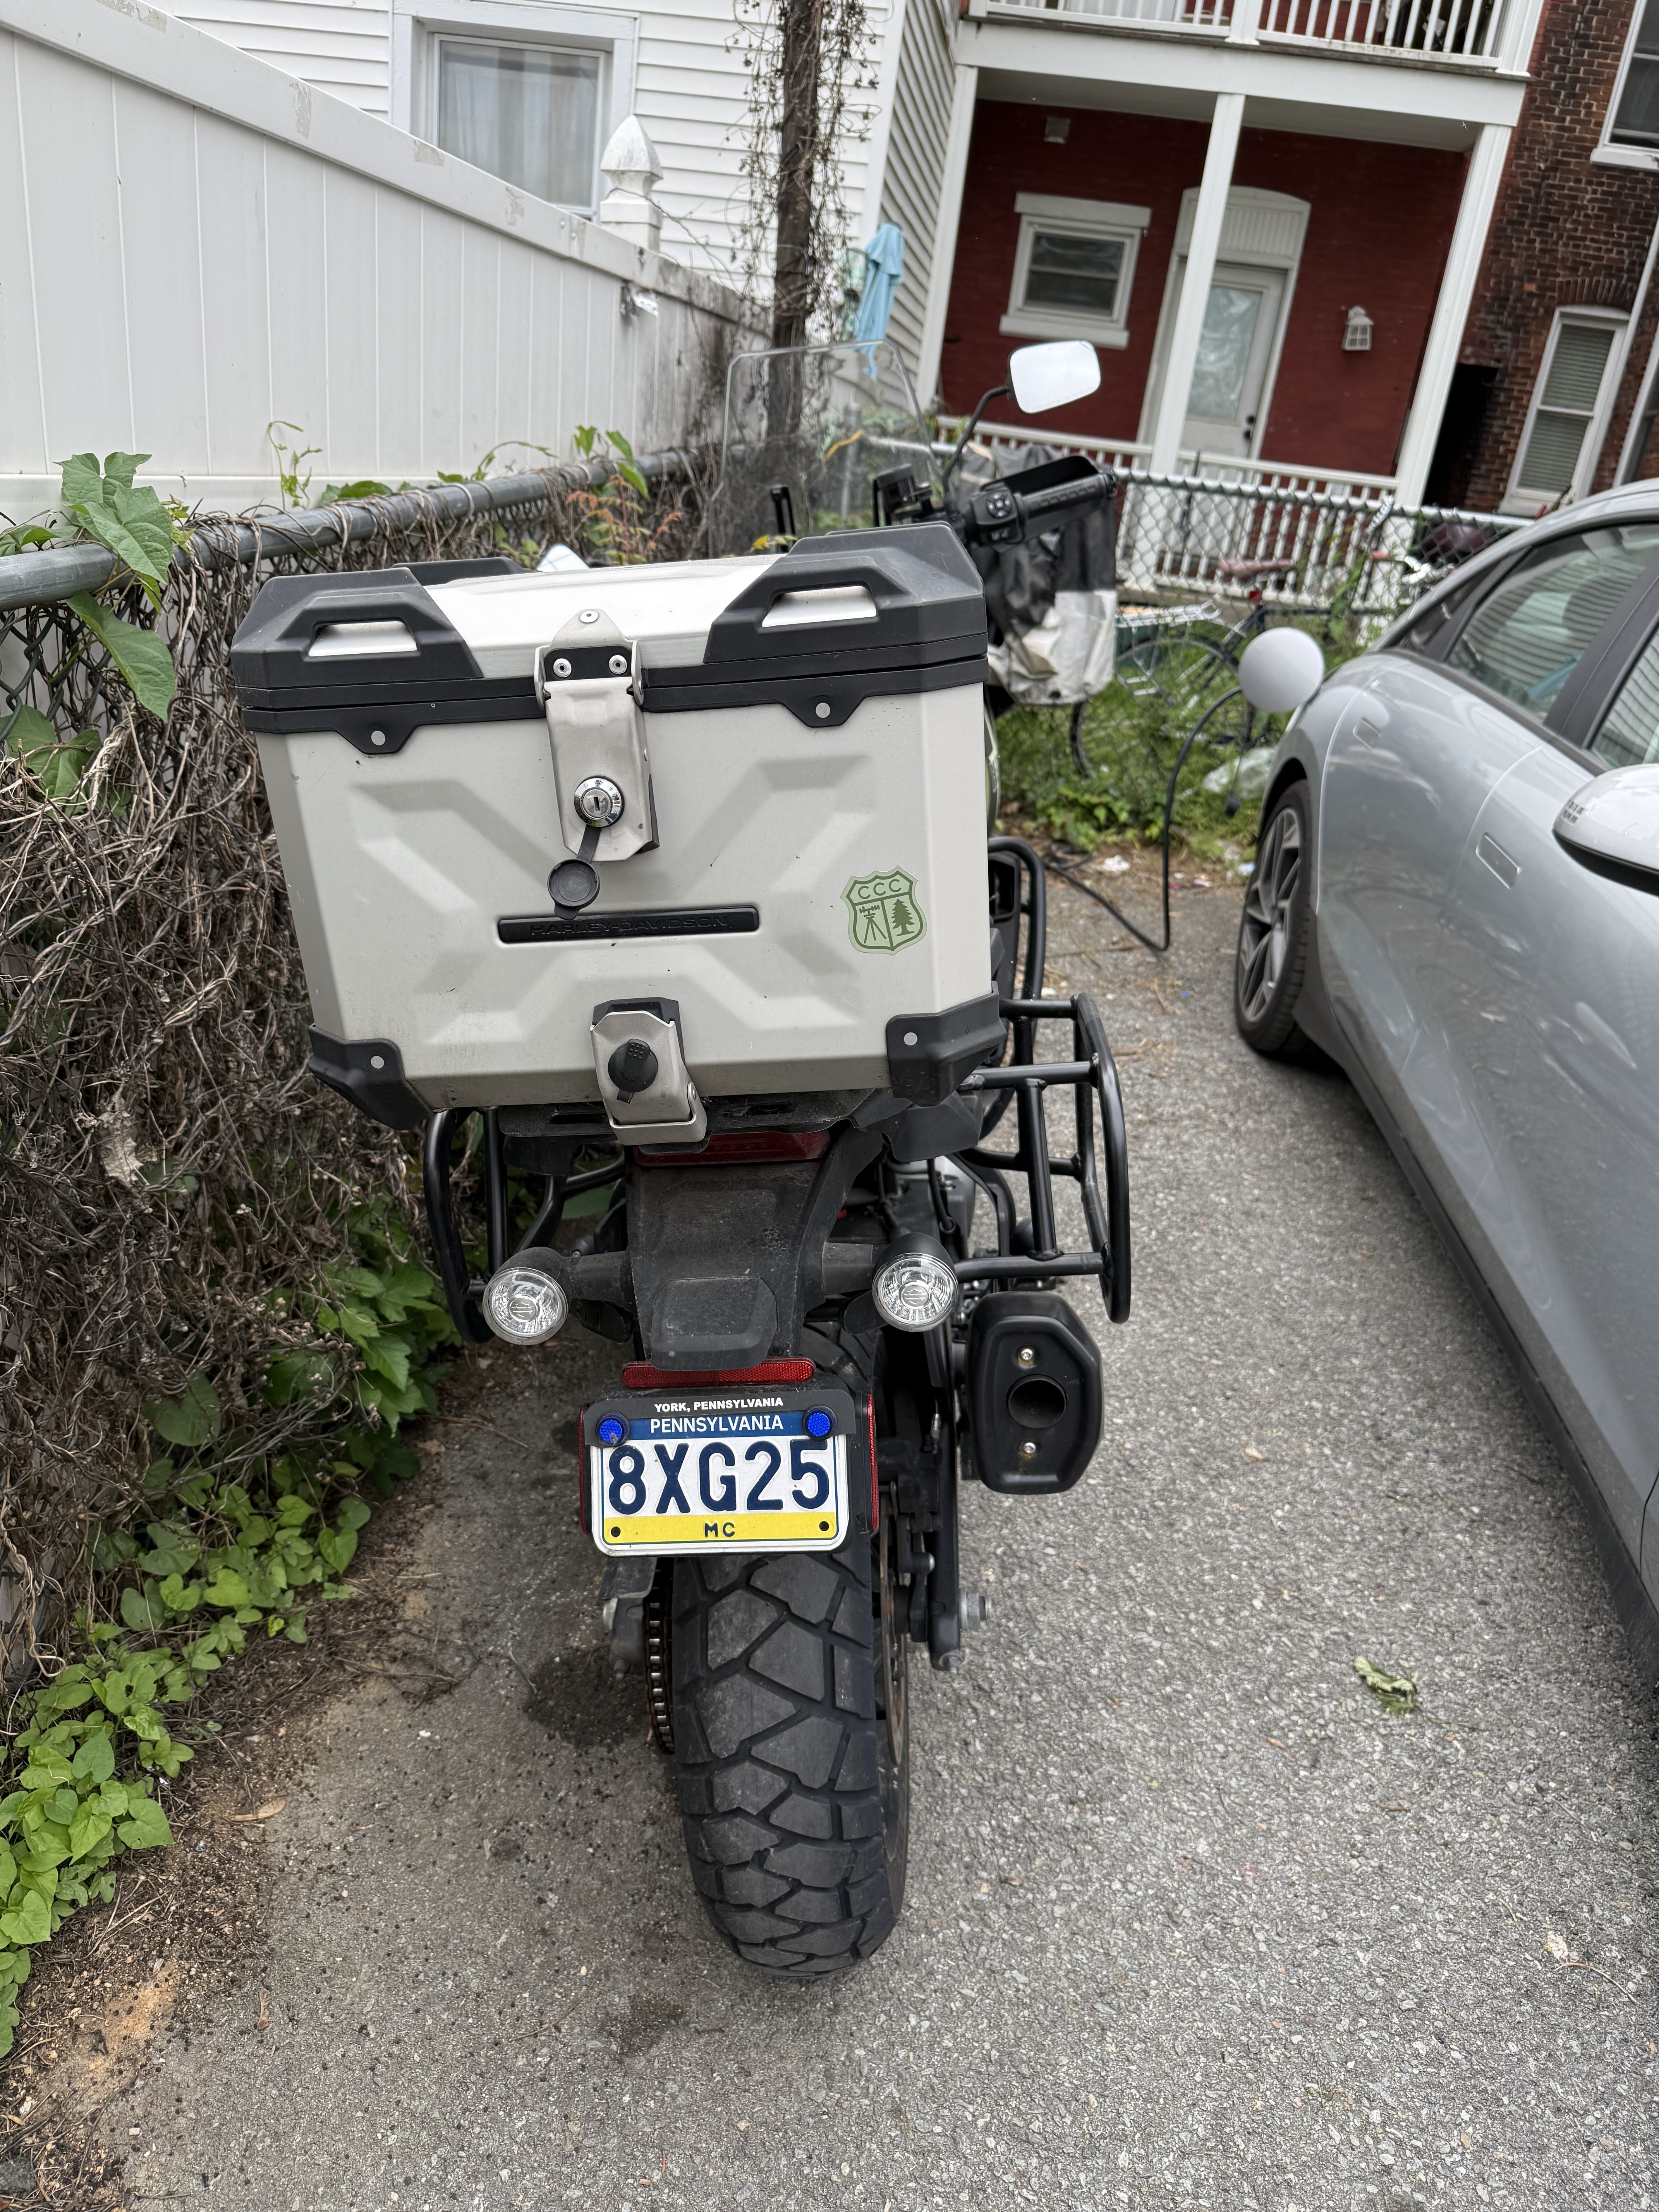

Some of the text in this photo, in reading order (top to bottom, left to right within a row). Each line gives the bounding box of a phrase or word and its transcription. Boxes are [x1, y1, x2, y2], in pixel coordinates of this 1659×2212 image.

[858, 879, 902, 899] CCC
[531, 915, 729, 936] HARLEY-DAVIDSON
[654, 1397, 784, 1413] YORK, PENNSYLVANIA
[650, 1415, 784, 1433] PENNSYLVANIA
[608, 1439, 829, 1515] 8XG25
[704, 1522, 736, 1537] MC
